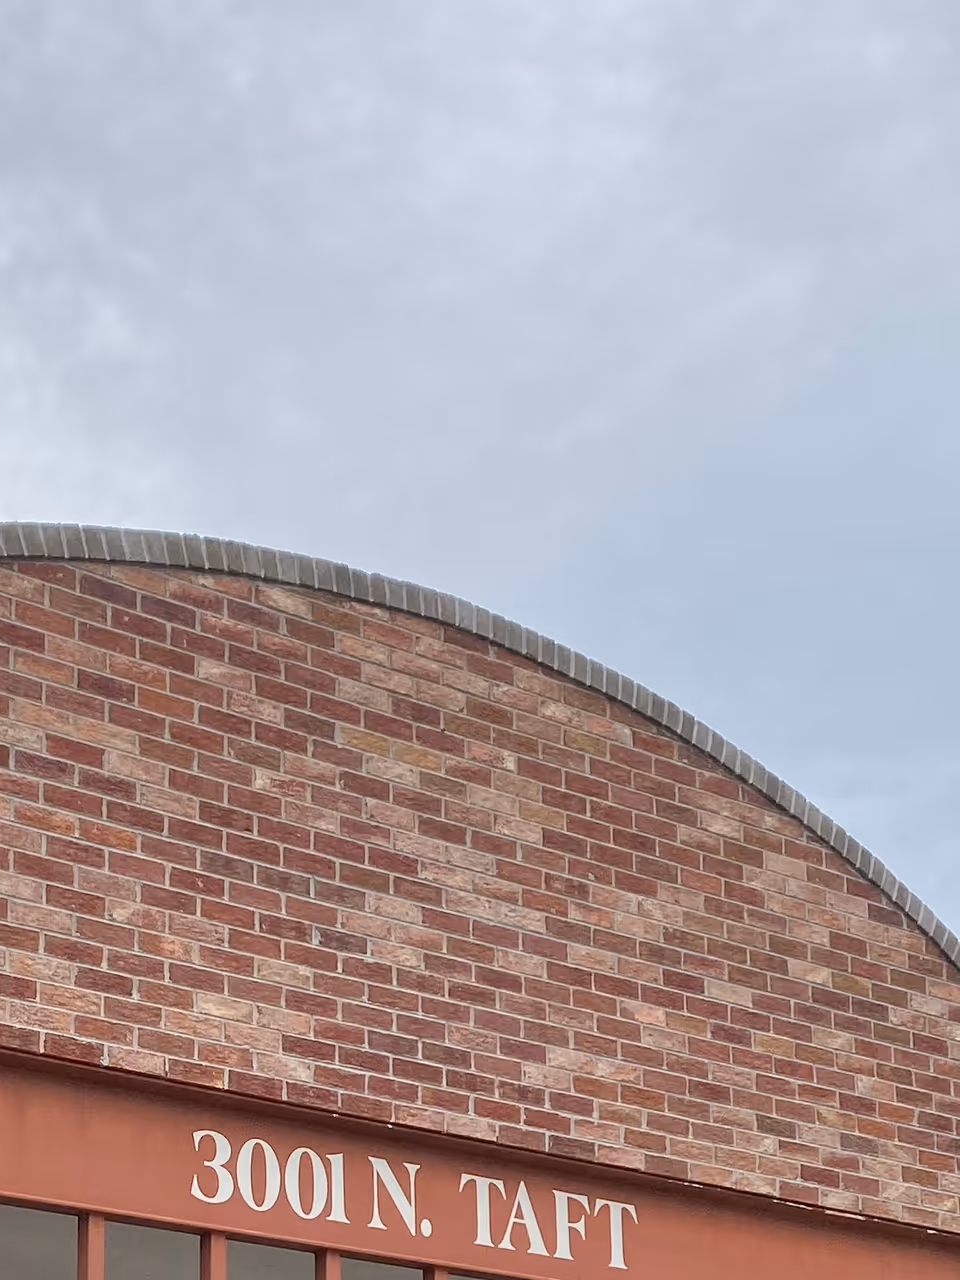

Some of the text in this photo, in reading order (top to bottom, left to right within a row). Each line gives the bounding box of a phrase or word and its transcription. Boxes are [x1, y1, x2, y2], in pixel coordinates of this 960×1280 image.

[190, 1129, 638, 1270] 3001 N. TAFT
